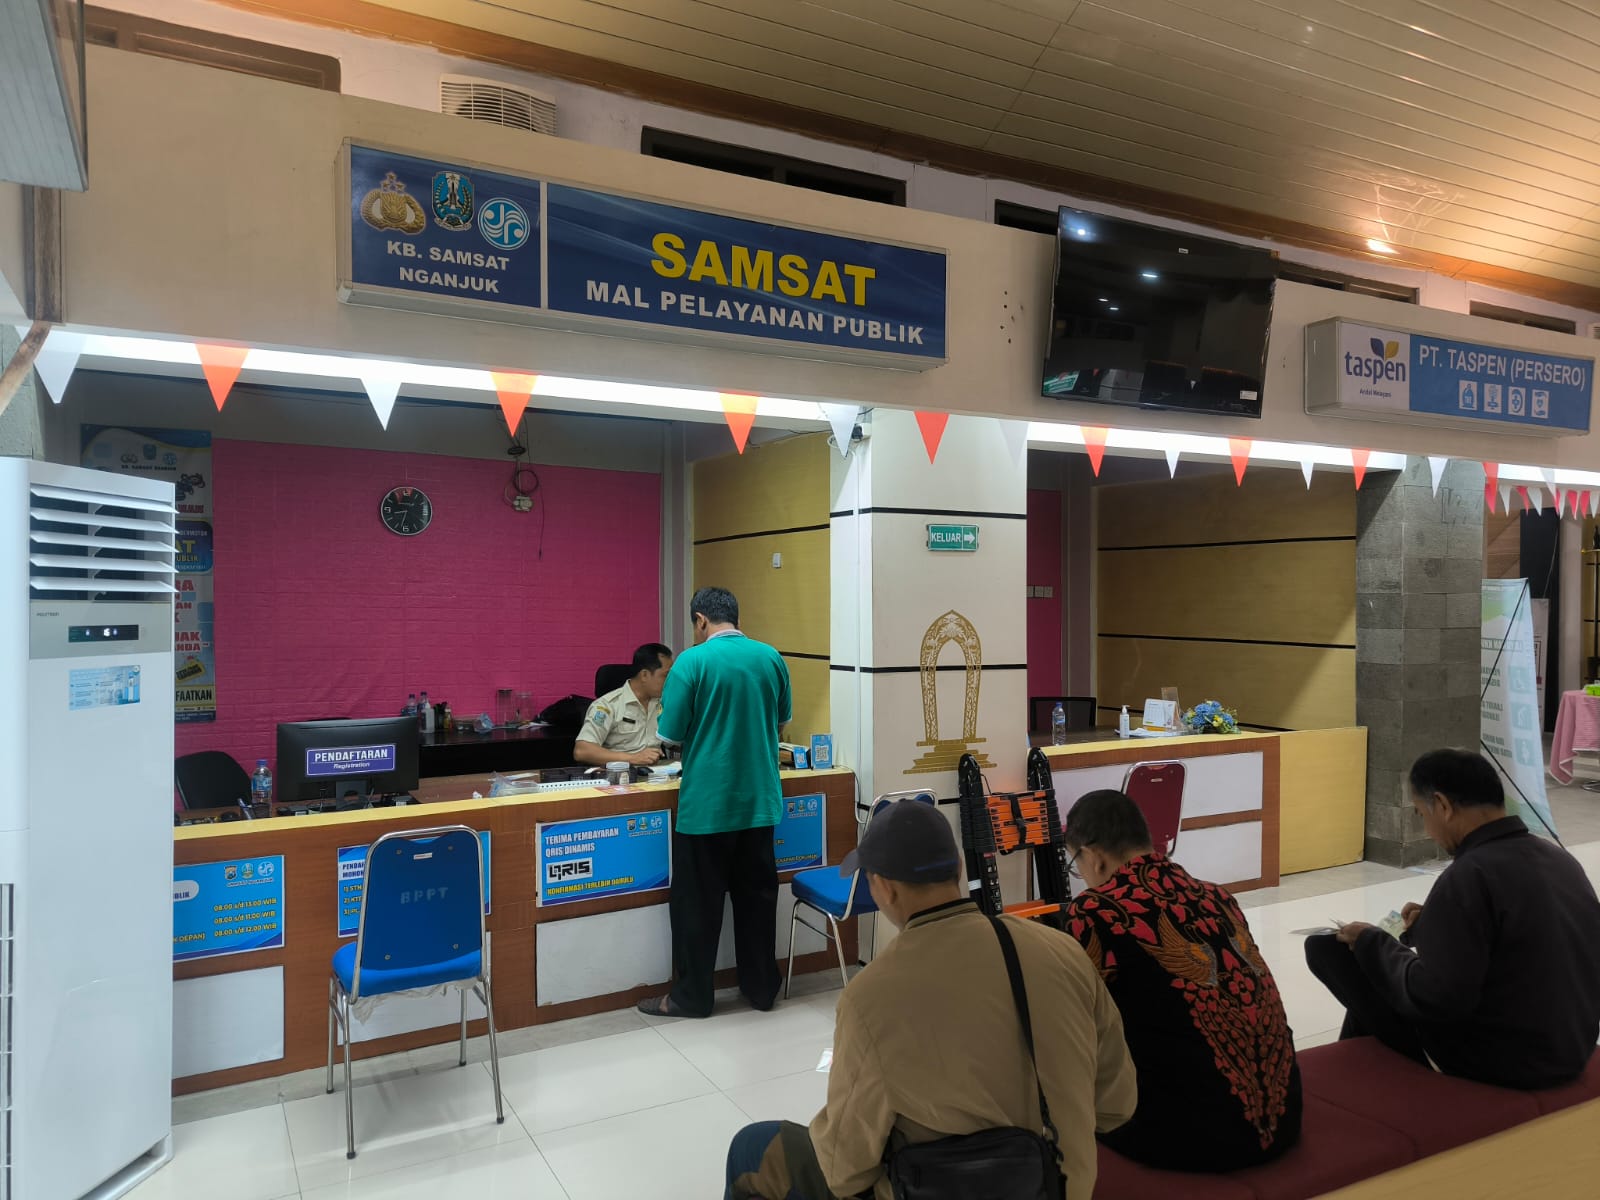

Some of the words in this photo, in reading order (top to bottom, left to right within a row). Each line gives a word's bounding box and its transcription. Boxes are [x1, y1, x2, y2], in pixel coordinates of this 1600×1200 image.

[387, 239, 422, 259] KB.
[429, 246, 510, 272] SAMSAT
[649, 232, 877, 307] SAMSAT
[399, 266, 500, 294] NGANJUK
[586, 279, 650, 310] MAL
[660, 290, 825, 333] PELAYANAN
[833, 316, 924, 346] PUBLIK
[1344, 351, 1406, 385] taspen
[1419, 344, 1443, 368] PT.
[1448, 348, 1506, 377] TASPEN
[1510, 358, 1586, 392] (PERSERO)
[931, 532, 961, 542] KELUAR
[314, 748, 388, 762] PENDAFTARAN
[333, 761, 371, 770] Registration
[545, 833, 572, 845] TERIMA
[573, 827, 619, 842] PEMBAYARAN
[545, 846, 563, 857] QRIS
[564, 842, 595, 855] DINAMIS
[549, 861, 590, 880] QRIS
[547, 884, 584, 896] KONFIRMASI
[585, 879, 611, 889] TERLEBIH
[261, 910, 276, 918] WIB
